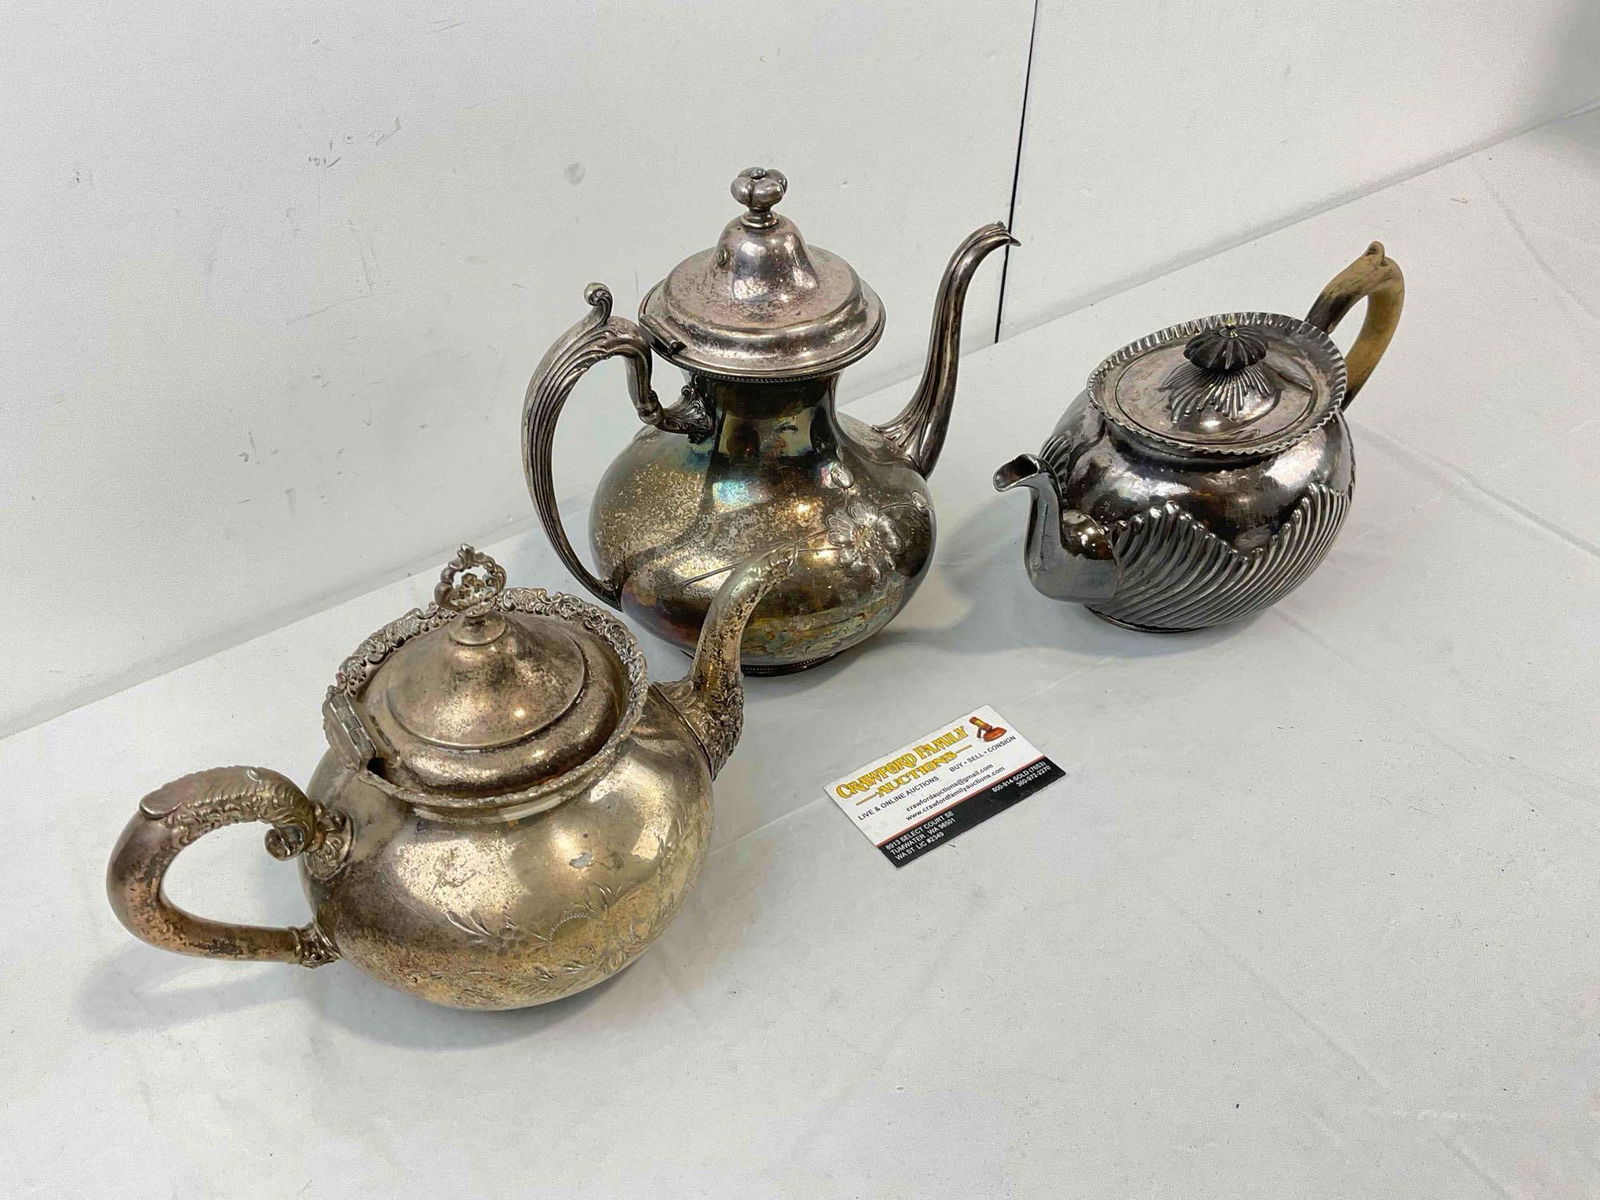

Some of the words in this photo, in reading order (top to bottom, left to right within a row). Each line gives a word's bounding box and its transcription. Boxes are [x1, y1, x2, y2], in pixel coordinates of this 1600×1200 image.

[835, 755, 918, 800] CRAWFORD
[912, 725, 969, 759] FAMILY
[876, 750, 958, 797] AUCTIONS
[948, 762, 964, 772] BUY
[966, 751, 984, 763] SELL
[986, 734, 1016, 753] CONSIGN
[857, 810, 873, 821] LIVE
[879, 792, 906, 809] ONLINE
[905, 776, 940, 796] AUCTIONS
[905, 763, 994, 812] crawfordauctions@gmail.com
[899, 826, 925, 842] SELECT
[922, 815, 946, 830] COURT
[926, 826, 940, 835] WA
